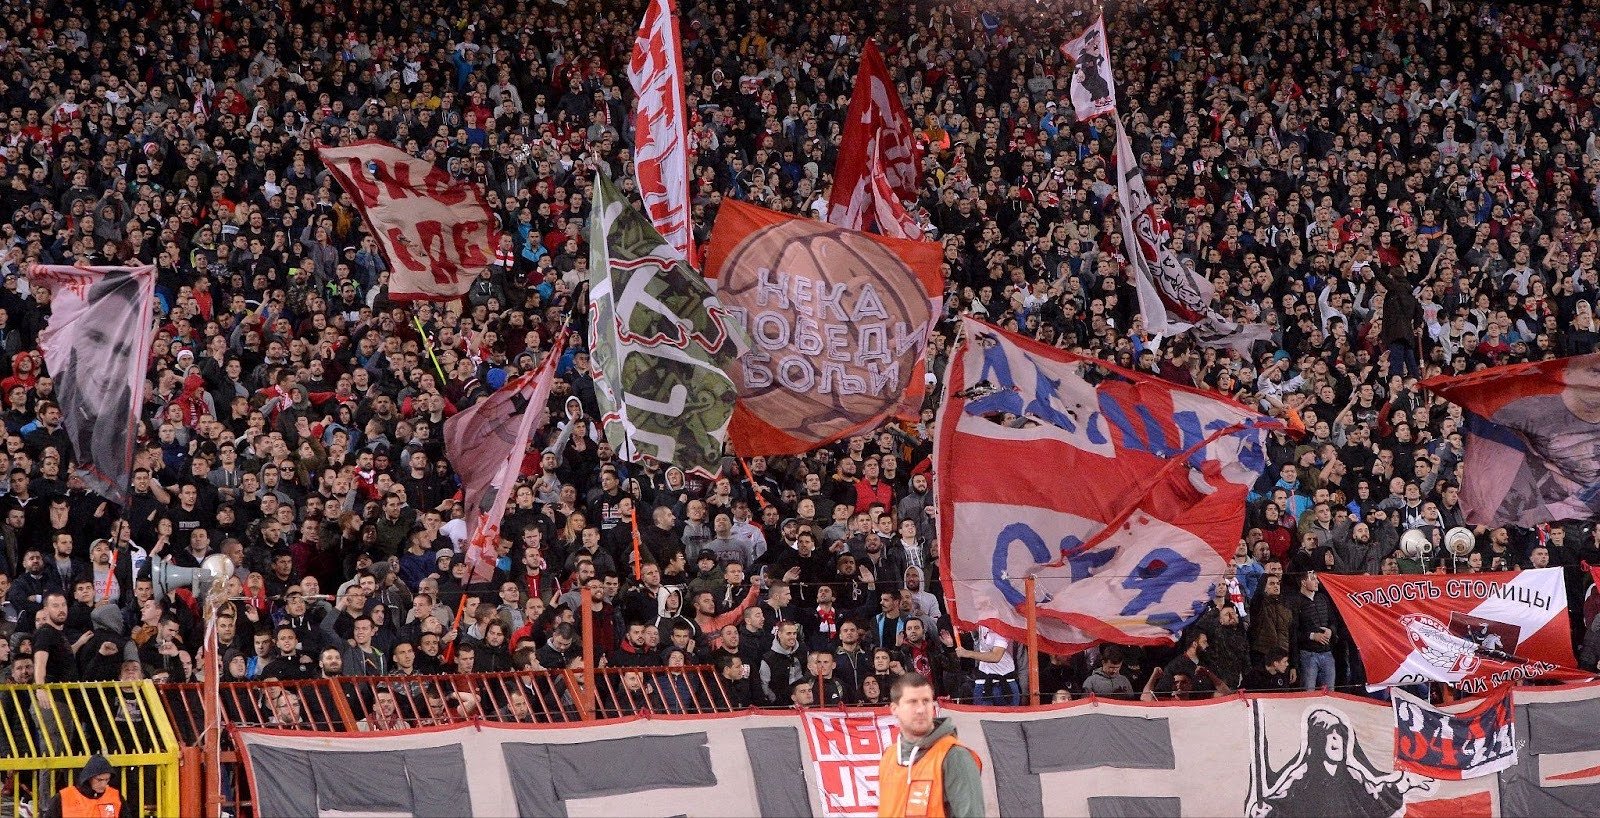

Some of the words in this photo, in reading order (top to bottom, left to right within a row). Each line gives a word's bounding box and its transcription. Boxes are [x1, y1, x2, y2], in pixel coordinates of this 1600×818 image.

[756, 266, 889, 322] НЕКА
[742, 351, 900, 397] БОЉИ
[1348, 582, 1440, 607] ГРДОСТЬ
[1445, 580, 1552, 611] СТОЛИЦЫ
